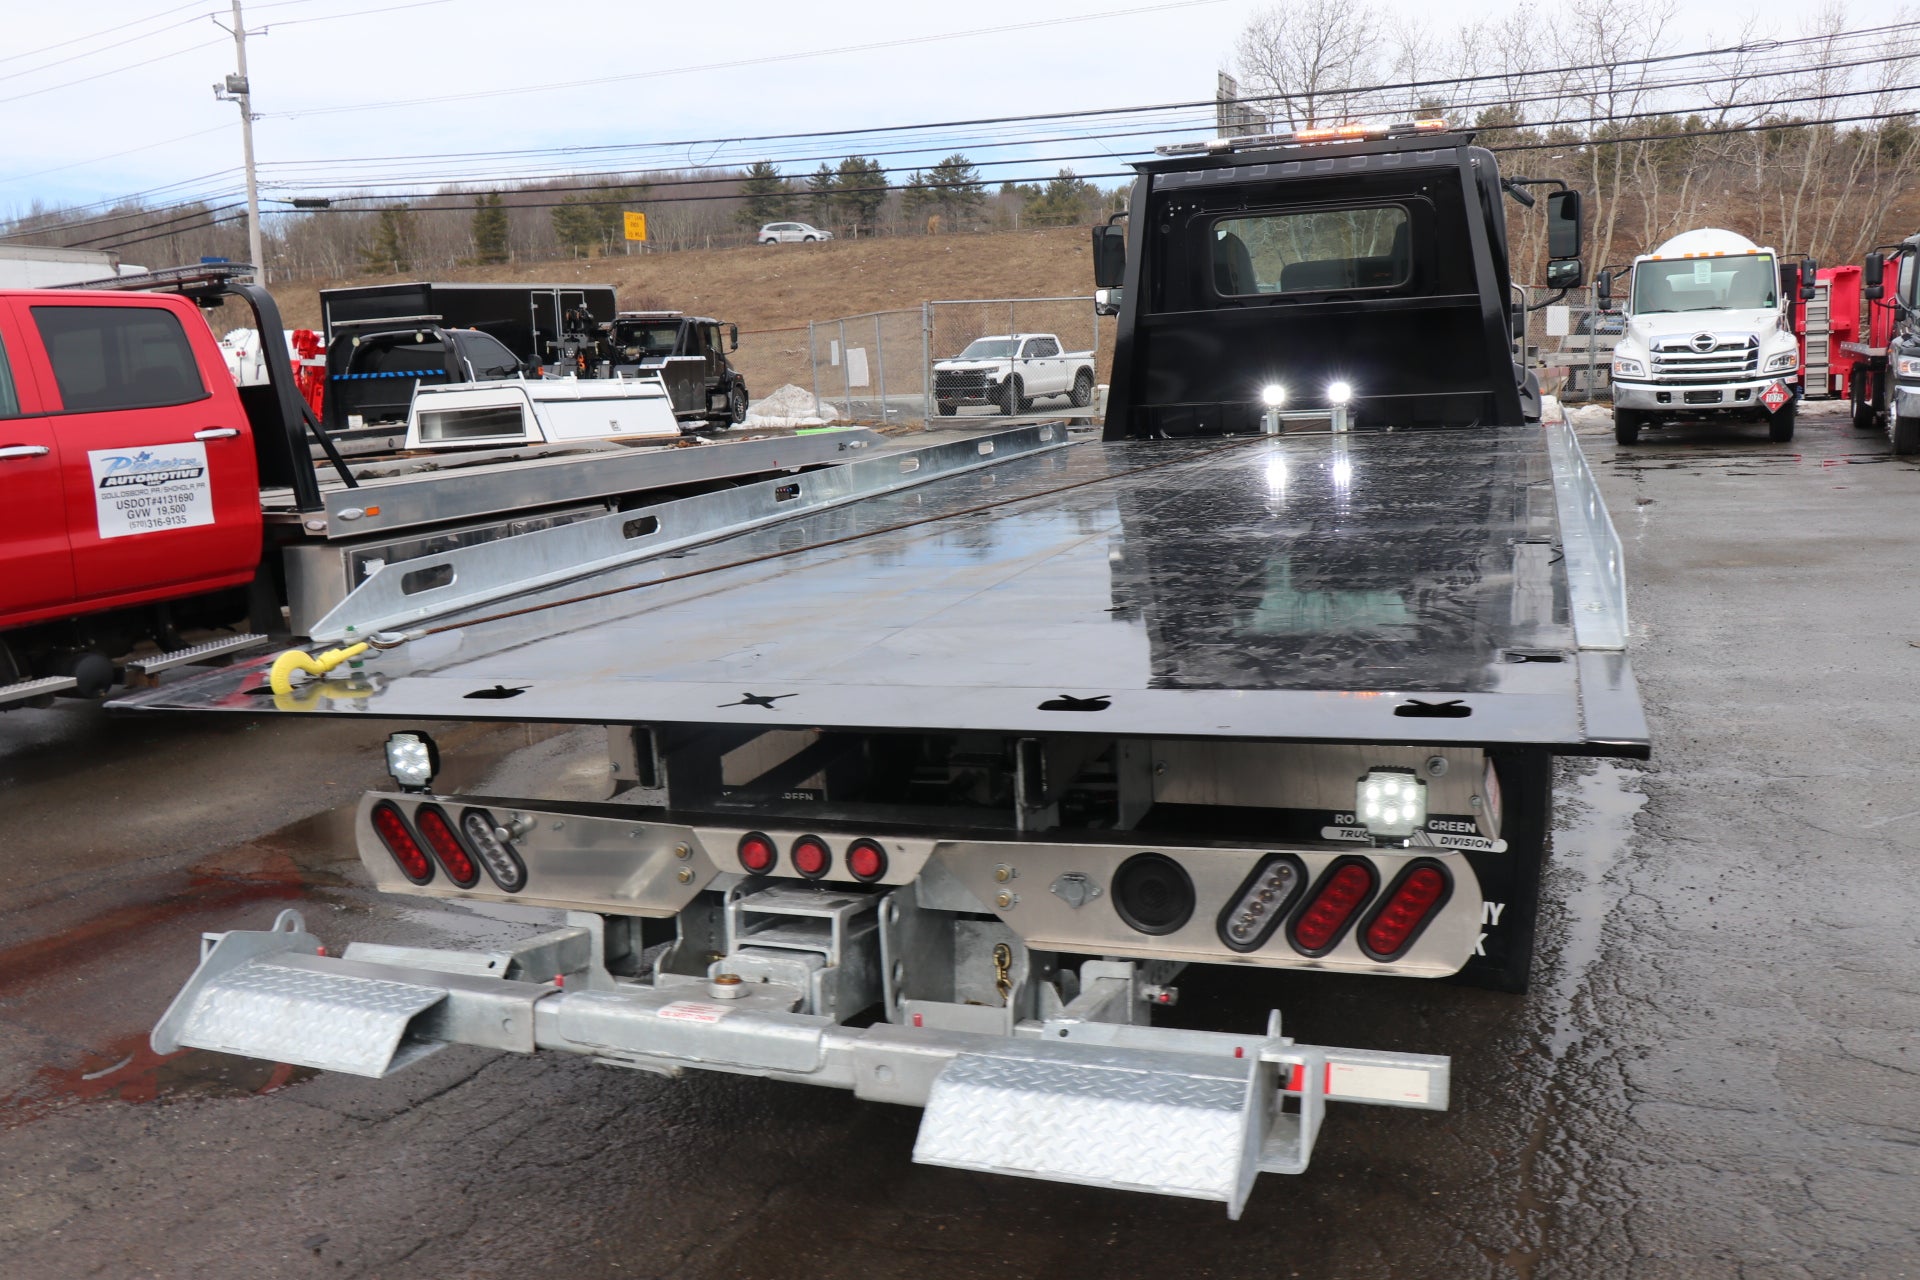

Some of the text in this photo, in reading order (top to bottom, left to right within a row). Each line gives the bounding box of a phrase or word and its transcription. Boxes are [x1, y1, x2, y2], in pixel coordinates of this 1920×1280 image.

[1767, 394, 1782, 402] 1075
[105, 468, 200, 486] AUTOMOTIVE
[116, 493, 195, 510] USDOT#4131690
[127, 508, 151, 520] GVW
[1428, 819, 1476, 833] GREEN
[1339, 829, 1493, 849] TRUC DIVISION
